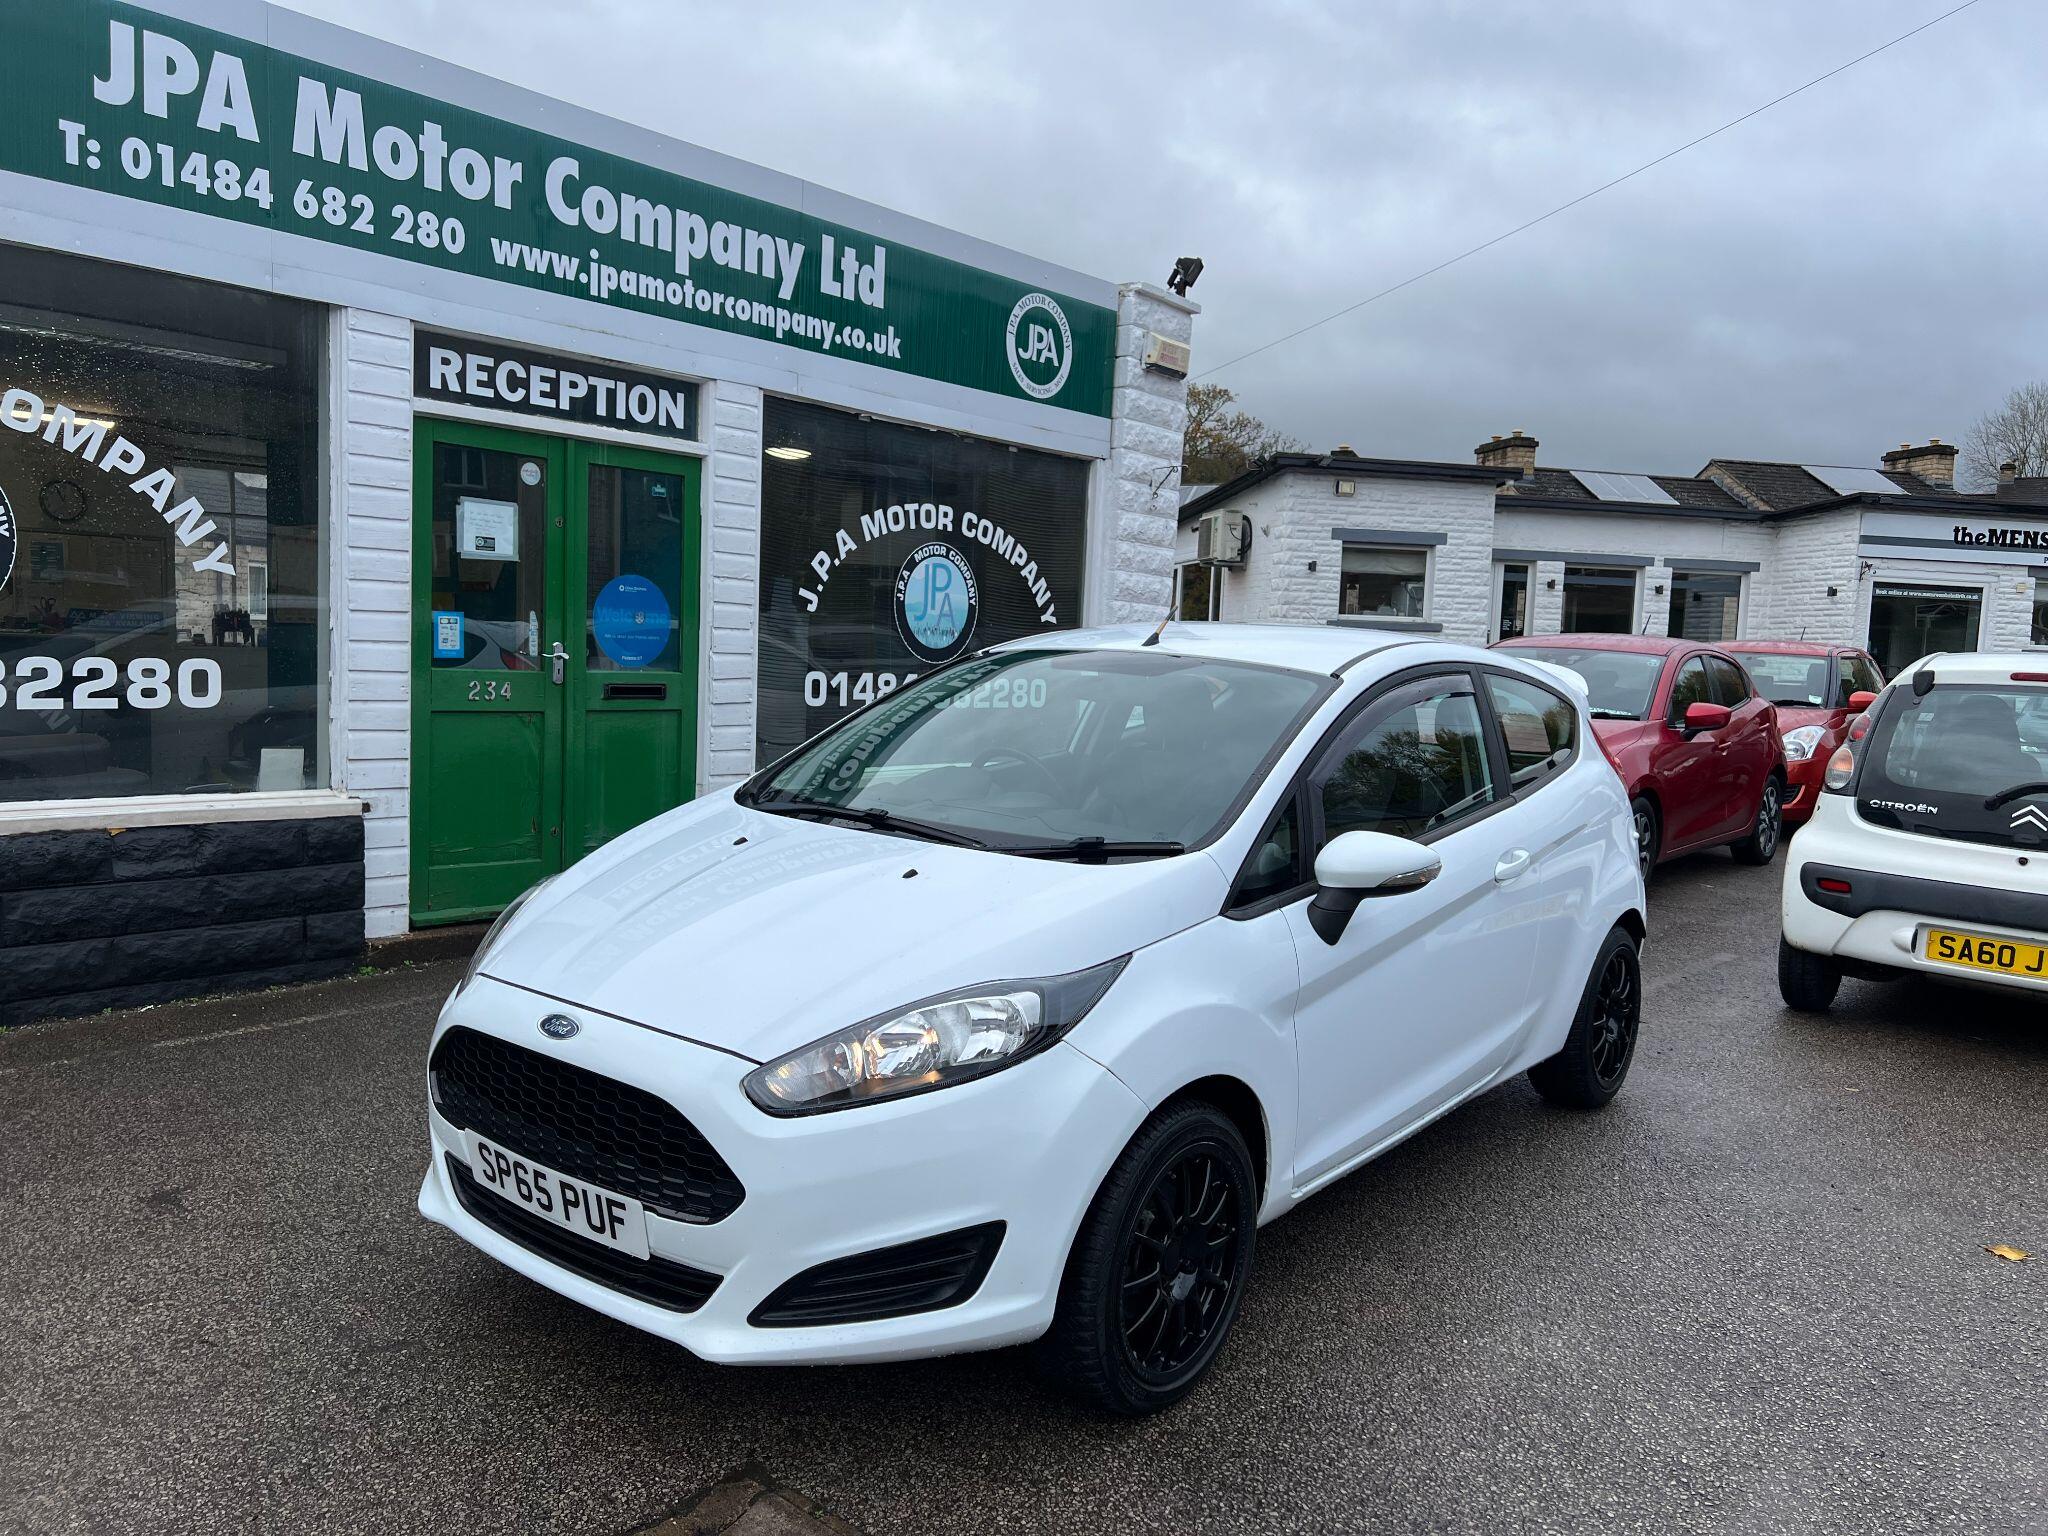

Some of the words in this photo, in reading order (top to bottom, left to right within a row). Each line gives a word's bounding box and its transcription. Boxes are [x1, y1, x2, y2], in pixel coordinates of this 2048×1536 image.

[94, 20, 260, 143] JPA
[292, 76, 523, 210] Motor
[545, 156, 805, 299] Company
[820, 234, 886, 309] Ltd
[59, 119, 102, 170] T:
[120, 136, 274, 211] 01484
[293, 179, 375, 235] 682
[391, 204, 466, 255] 280
[491, 236, 902, 359] www.jpamotorcompany.co.uk
[1018, 295, 1047, 312] MOTOR
[1047, 300, 1072, 351] COMPANY
[1018, 323, 1059, 367] JPA
[430, 346, 685, 430] RECEPTION
[798, 528, 858, 613] J.P.A
[860, 502, 954, 543] MOTOR
[961, 511, 1057, 625] COMPANY
[914, 545, 947, 563] MOTOR
[948, 550, 977, 606] COMPANY
[0, 656, 222, 710] 2280
[468, 680, 511, 701] 234
[804, 670, 919, 707] 0148
[933, 678, 1047, 708] 2280
[1869, 799, 1939, 815] CITROËN
[1938, 935, 2017, 969] SA60
[544, 1018, 572, 1036] Ford
[477, 1141, 554, 1213] SP65
[558, 1179, 627, 1241] PUF
